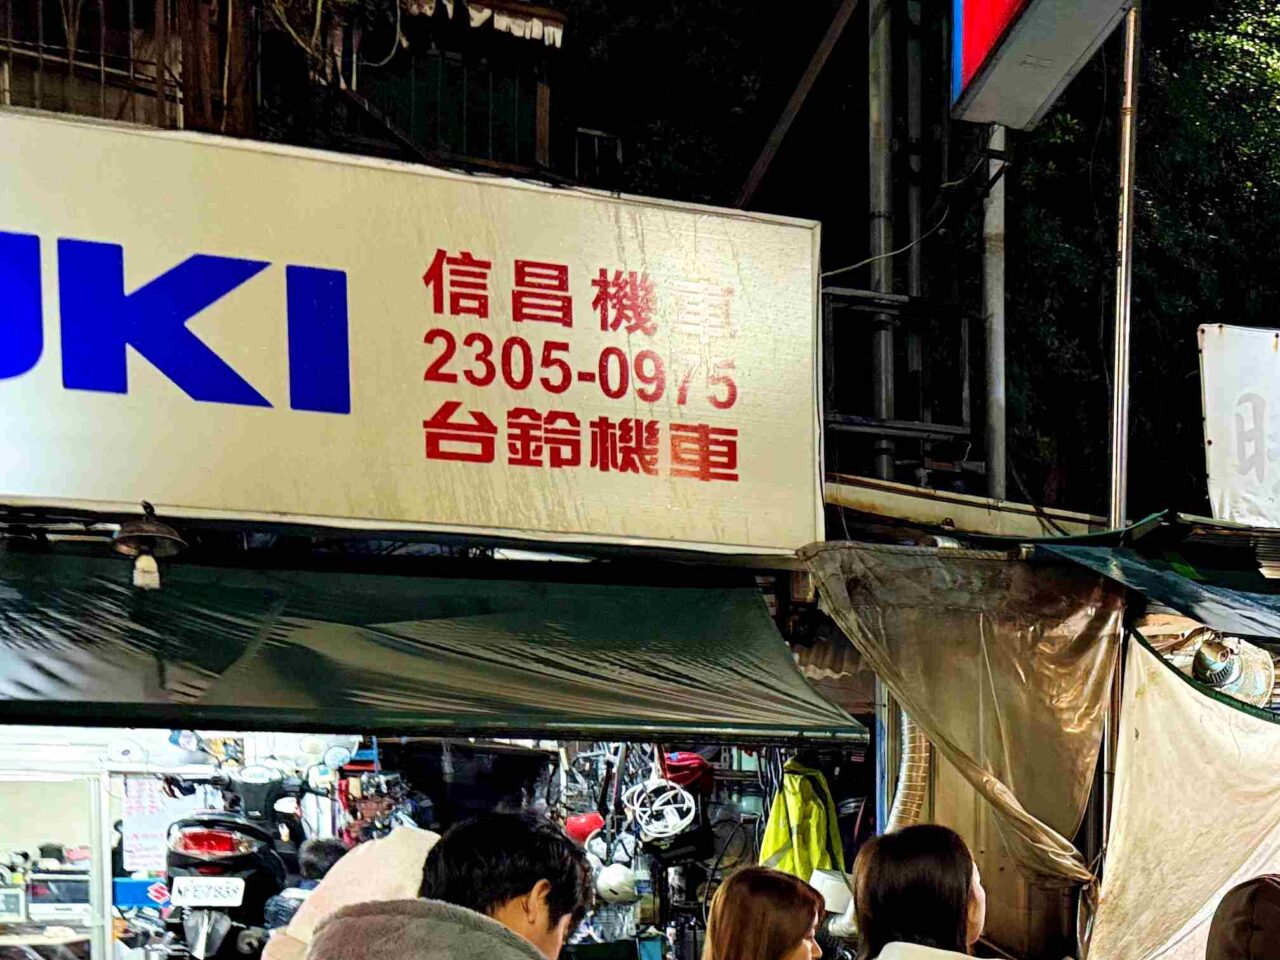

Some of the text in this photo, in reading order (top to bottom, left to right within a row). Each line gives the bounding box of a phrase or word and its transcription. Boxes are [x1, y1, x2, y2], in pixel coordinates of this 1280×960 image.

[422, 248, 736, 339] 信昌機車
[423, 328, 738, 410] 2305-0975
[422, 400, 739, 482] 台鈴機車
